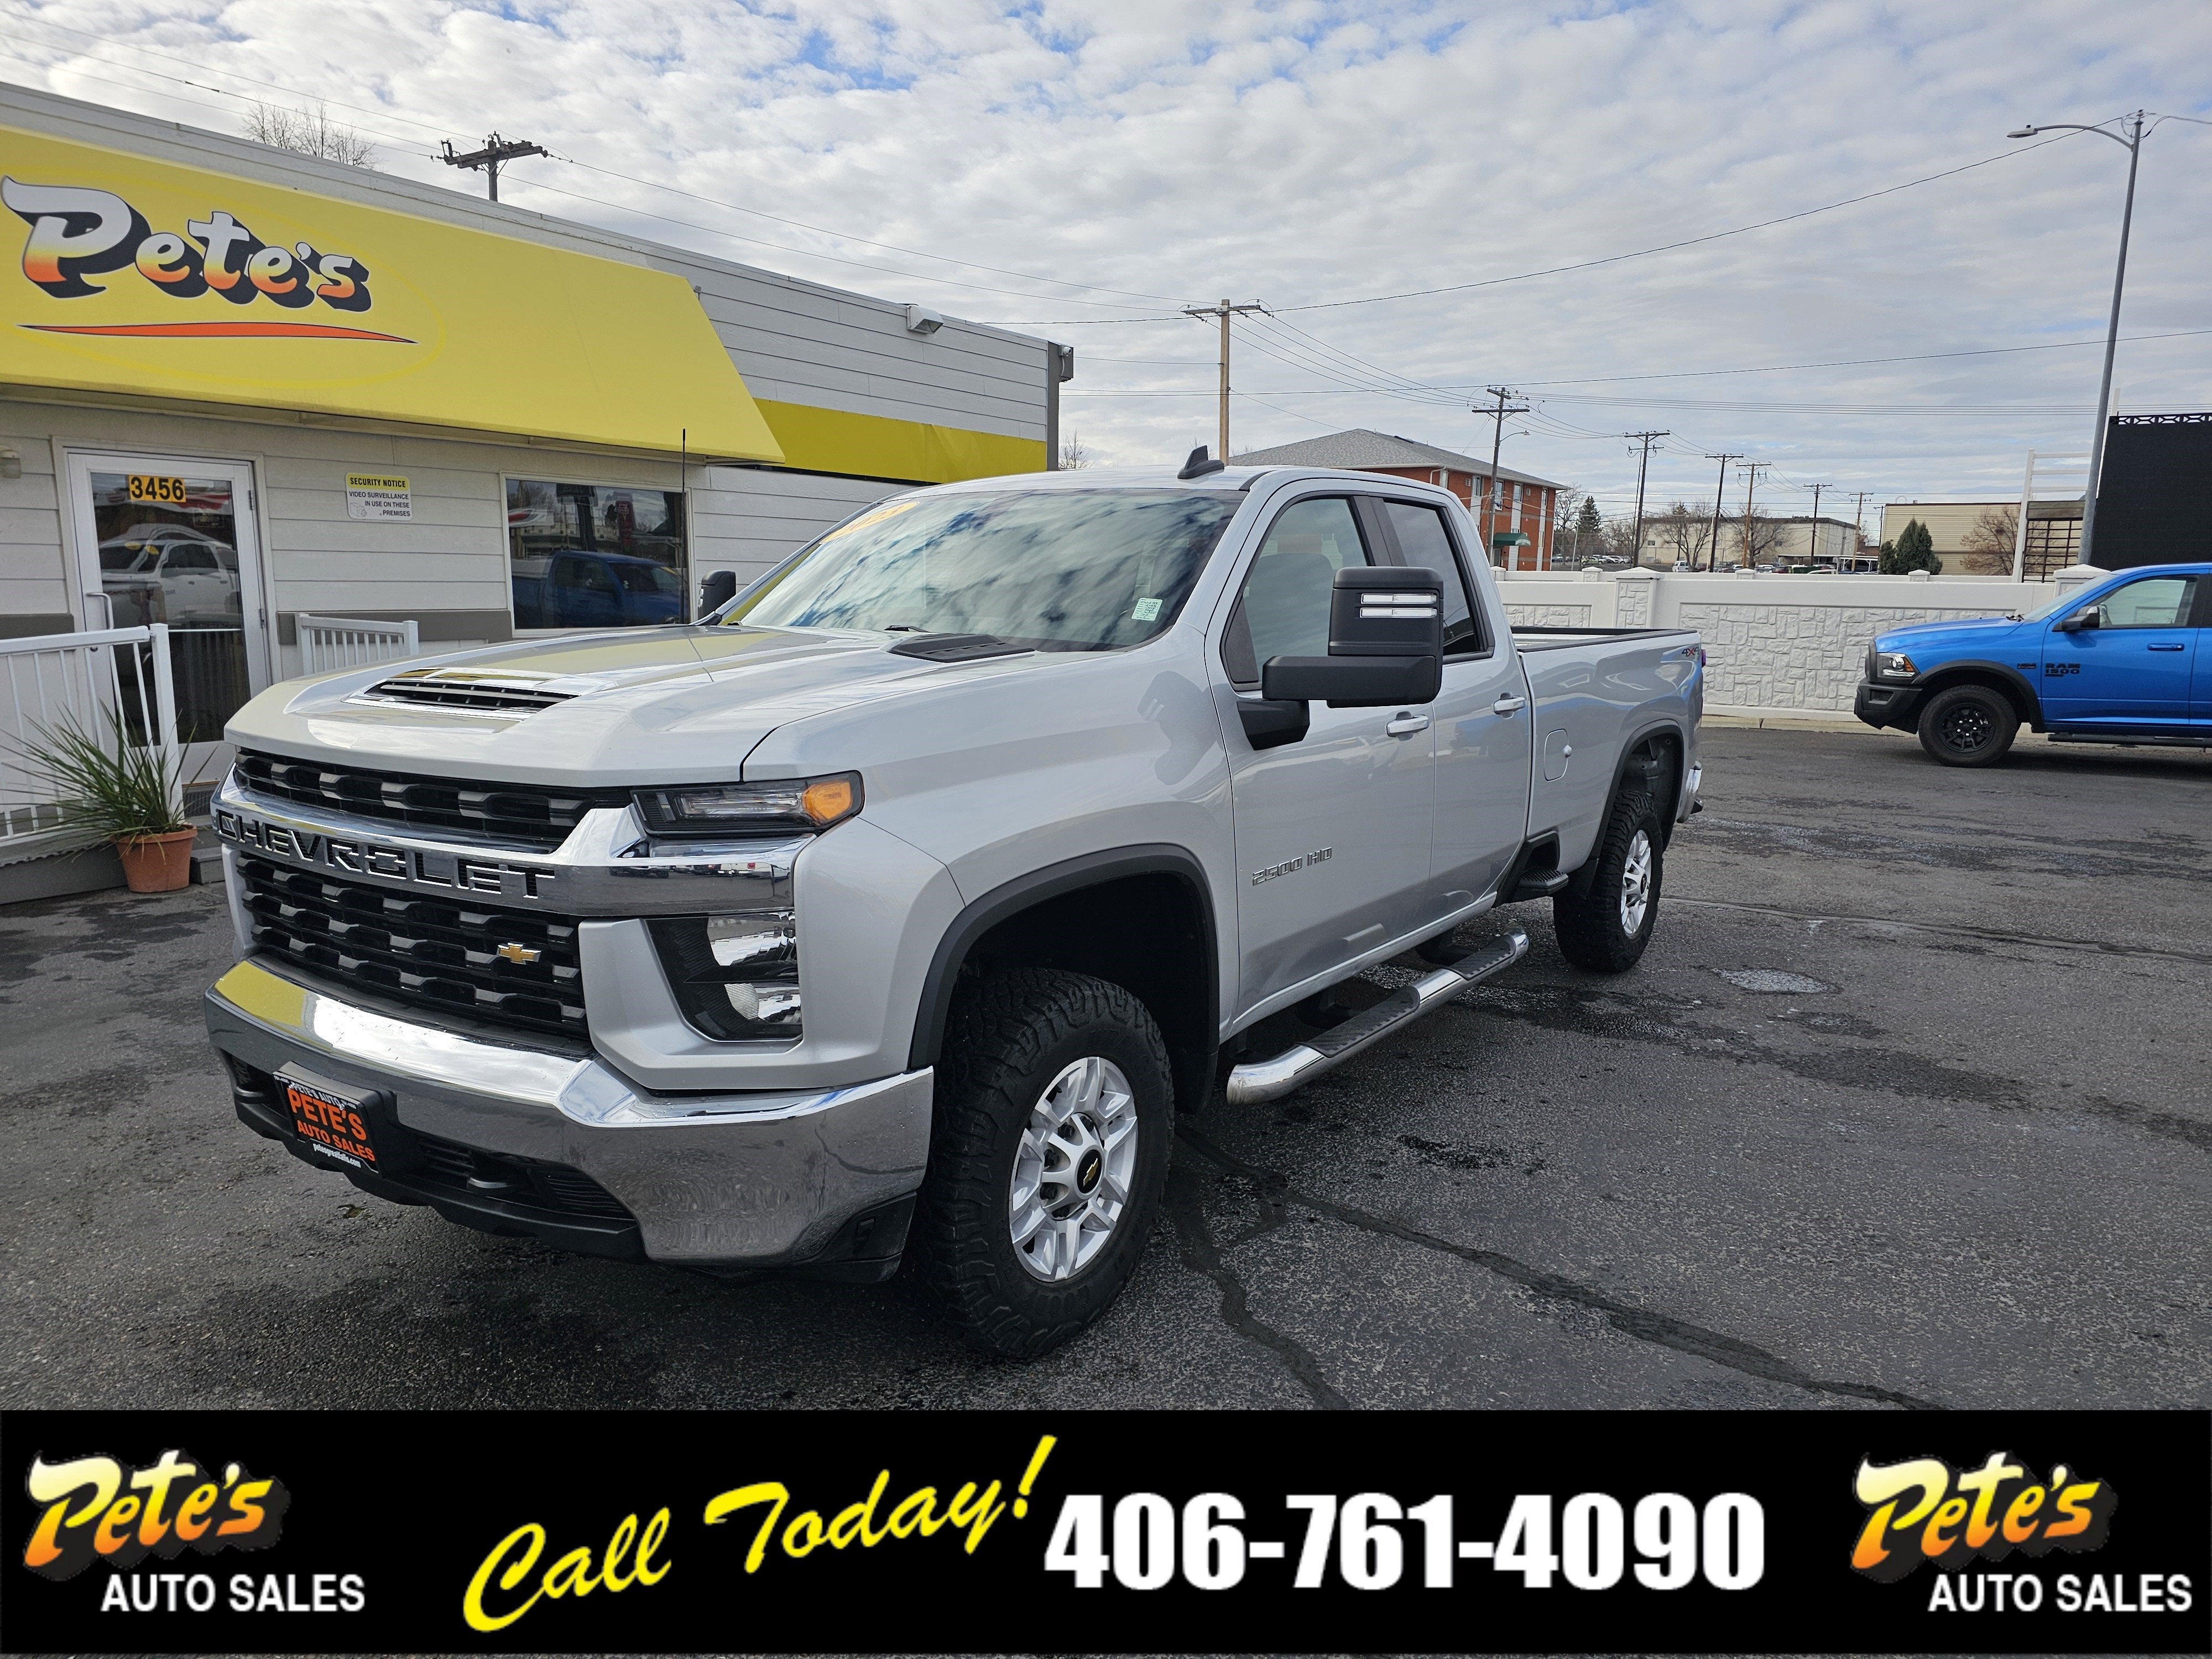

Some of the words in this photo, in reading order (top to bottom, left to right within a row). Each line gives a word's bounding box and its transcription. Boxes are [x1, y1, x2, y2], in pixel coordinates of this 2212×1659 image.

[1, 175, 372, 312] Pete's
[131, 476, 184, 500] 3456
[350, 477, 381, 486] SECURITY
[383, 479, 406, 488] NOTICE
[216, 810, 556, 899] CHEVROLET
[1252, 857, 1303, 886] 2500
[1307, 846, 1332, 866] HD
[287, 1087, 367, 1140] PETE'S
[297, 1120, 331, 1144] AUTO
[332, 1134, 375, 1161] SALES
